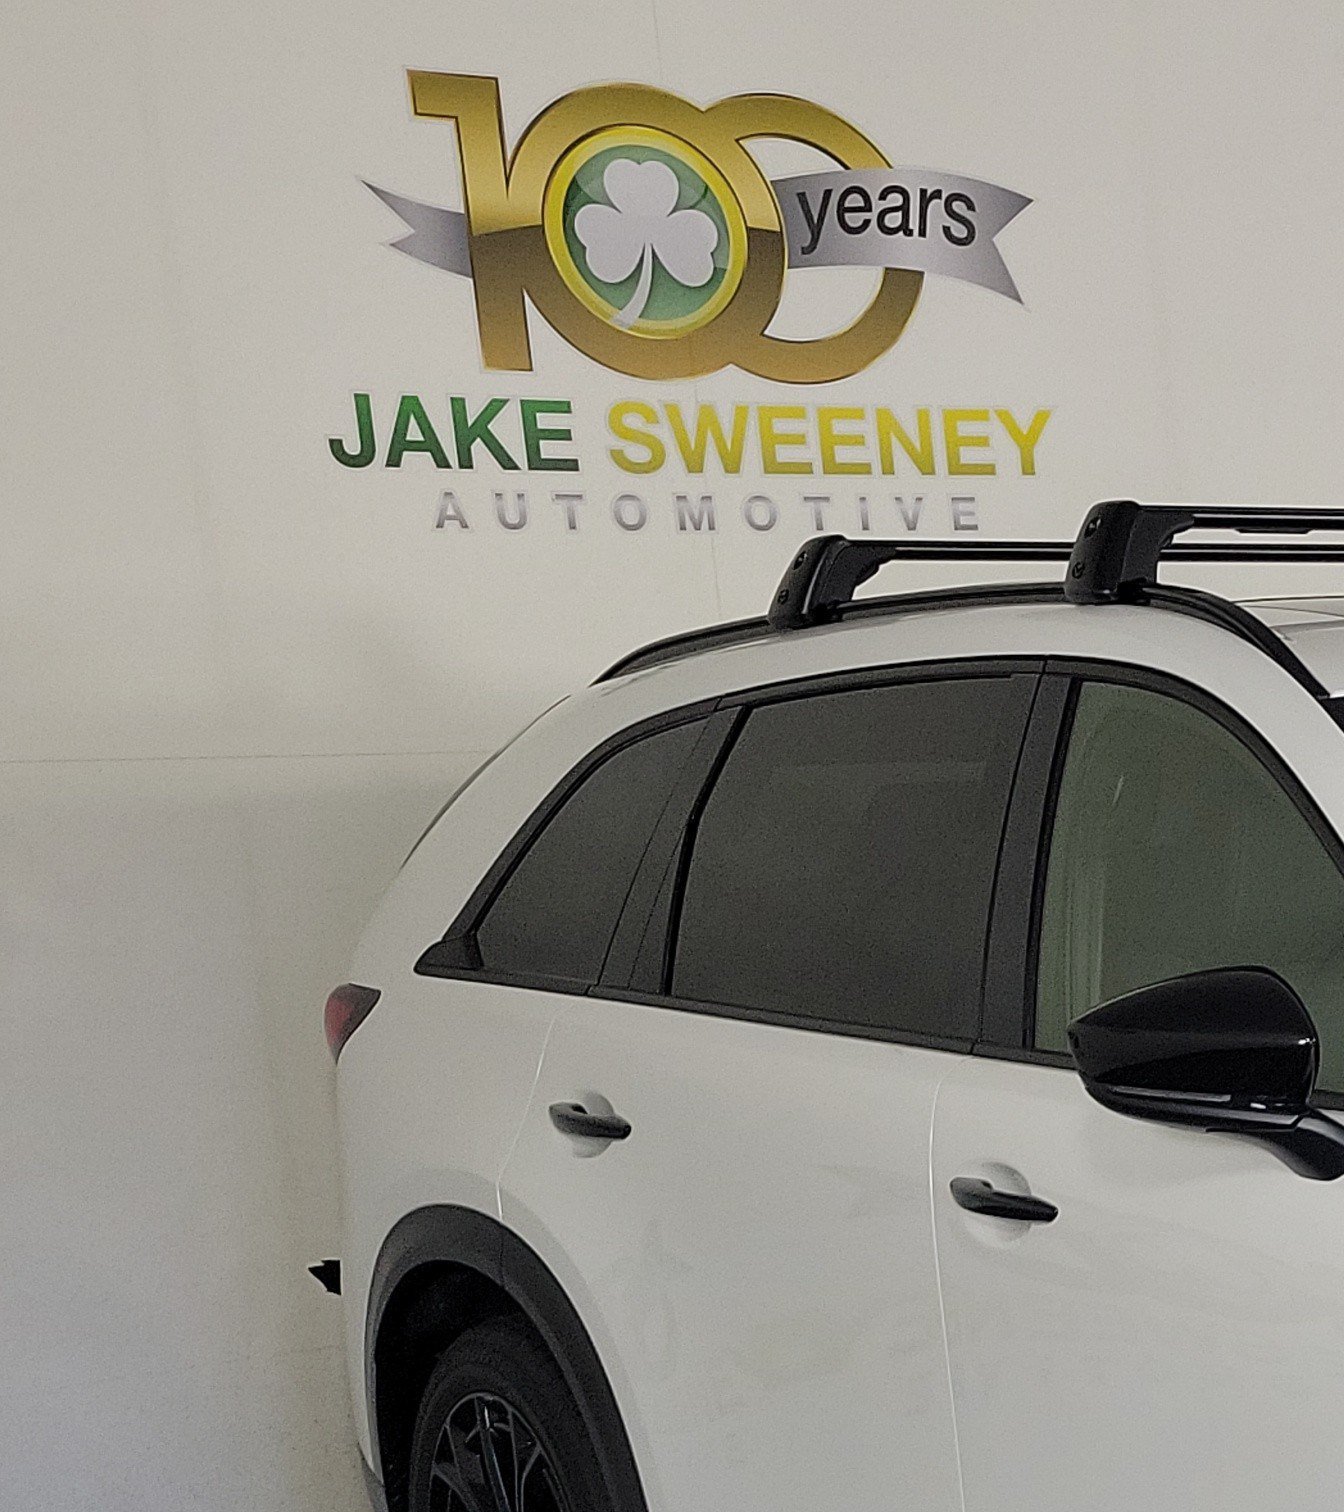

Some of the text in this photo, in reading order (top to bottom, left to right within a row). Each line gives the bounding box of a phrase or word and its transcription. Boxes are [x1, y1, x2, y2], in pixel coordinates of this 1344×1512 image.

[406, 67, 978, 385] 100 years
[328, 391, 1053, 476] JAKE SWEENEY
[435, 490, 980, 533] AUTOMOTIVE
